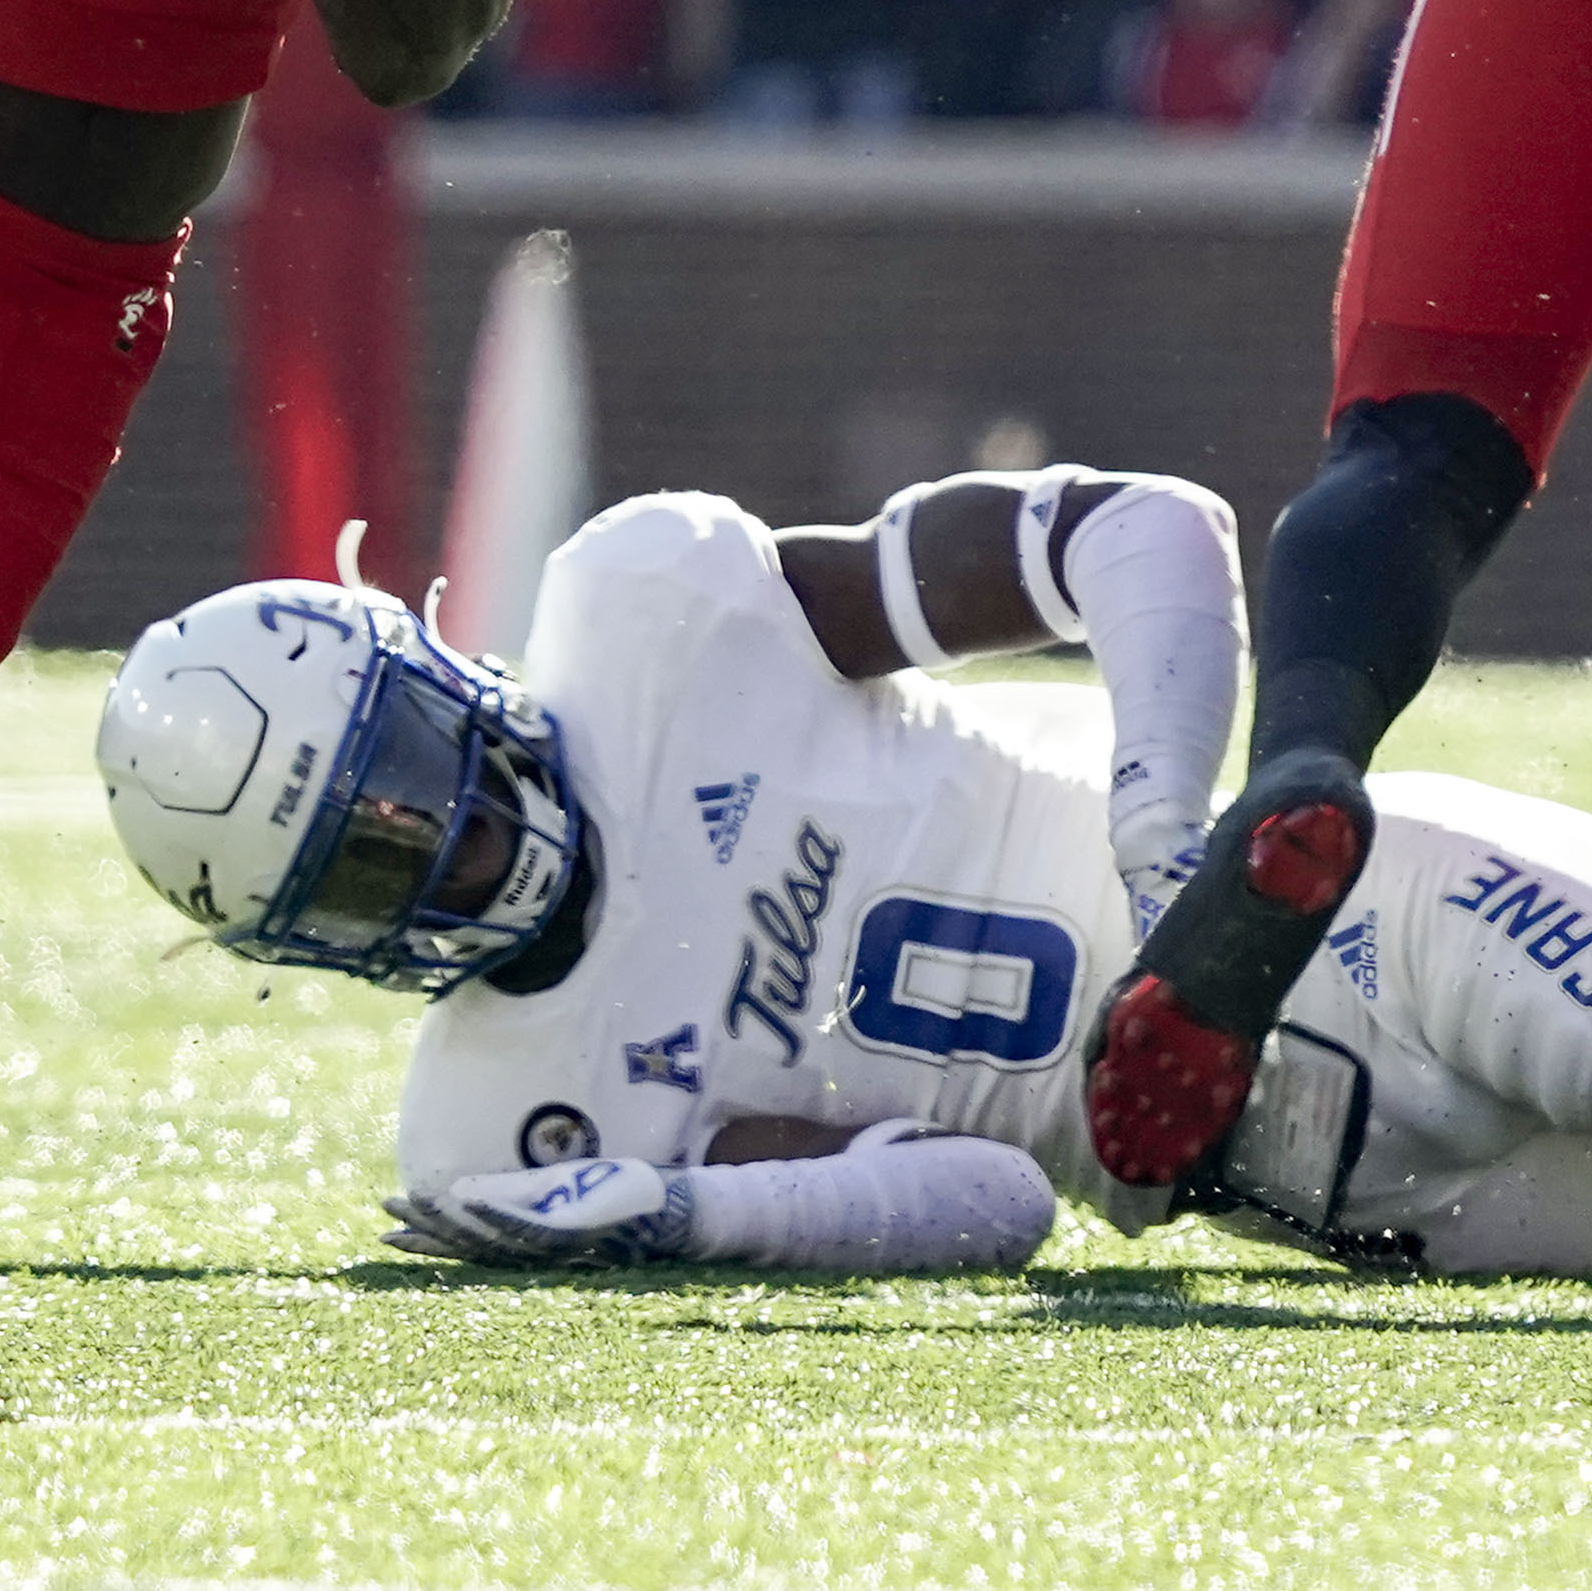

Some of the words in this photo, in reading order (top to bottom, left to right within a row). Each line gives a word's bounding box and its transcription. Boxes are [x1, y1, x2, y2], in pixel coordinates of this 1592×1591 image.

[721, 813, 845, 1070] Tulsa
[844, 886, 1087, 1071] 0
[1360, 909, 1380, 1001] adidas
